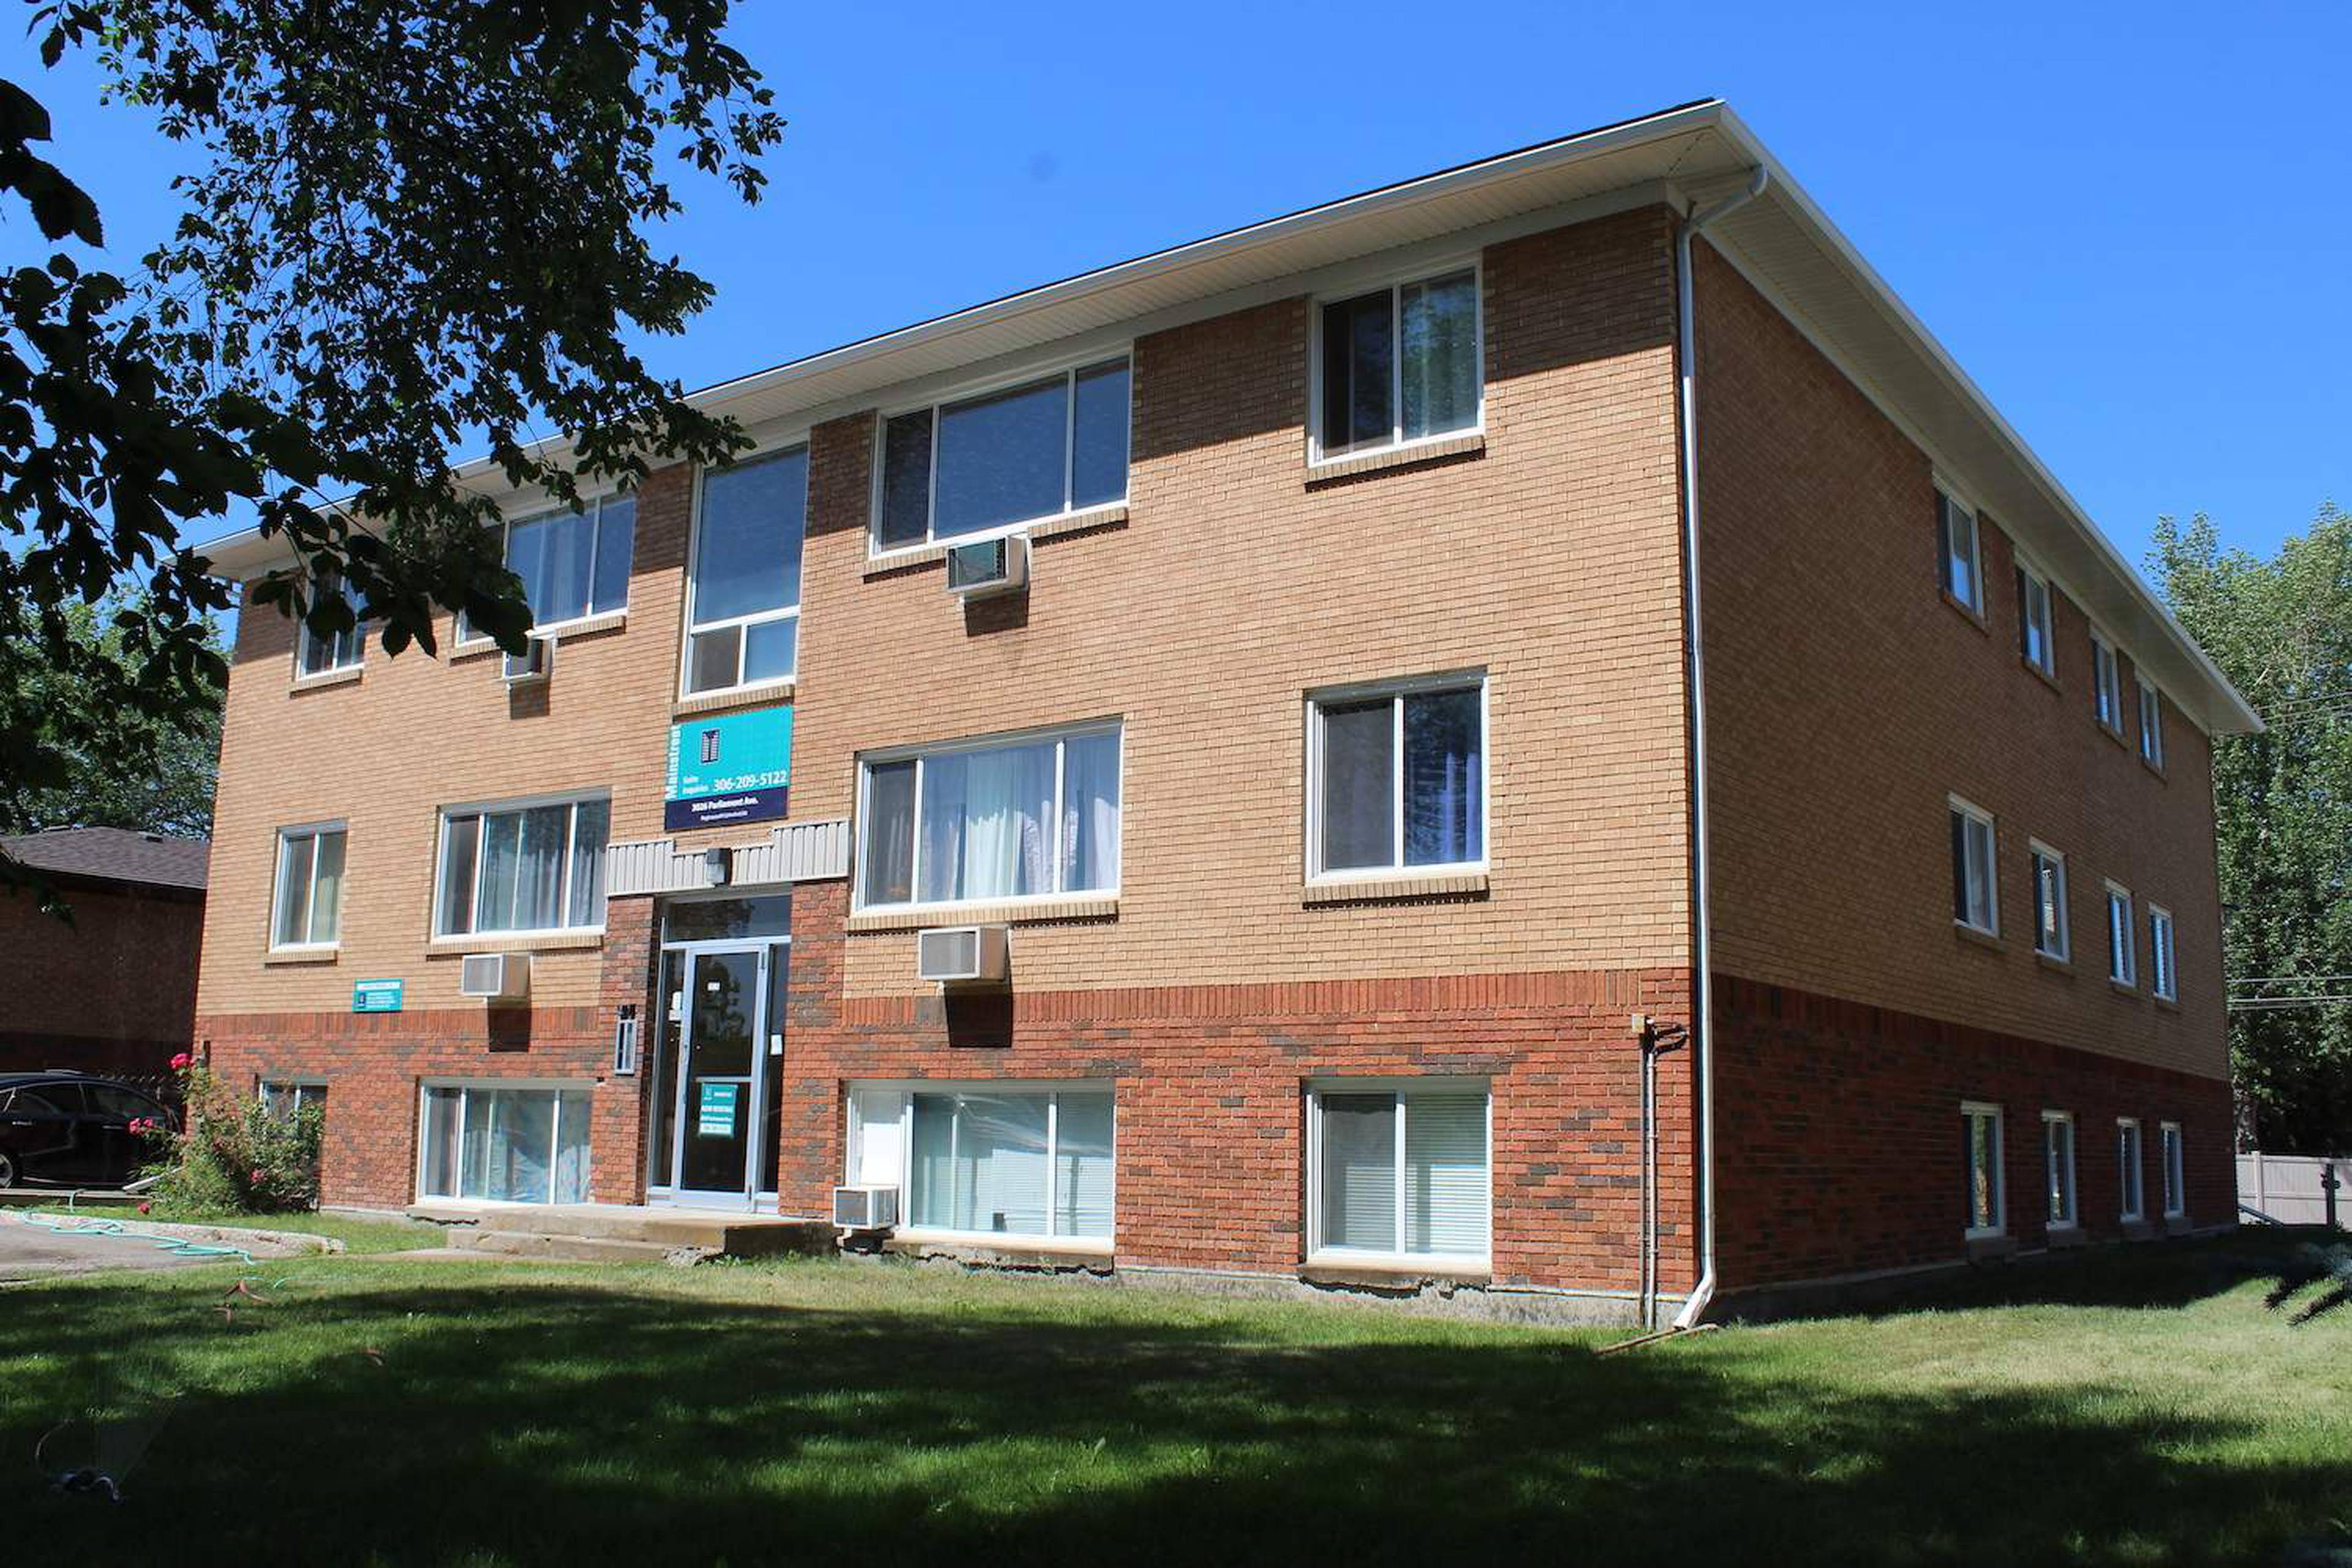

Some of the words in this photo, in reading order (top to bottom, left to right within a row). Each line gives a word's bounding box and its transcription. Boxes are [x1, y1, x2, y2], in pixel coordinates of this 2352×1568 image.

[666, 725, 680, 800] Mainstreet
[714, 770, 787, 791] 306-209-5122
[709, 798, 744, 809] Parliament
